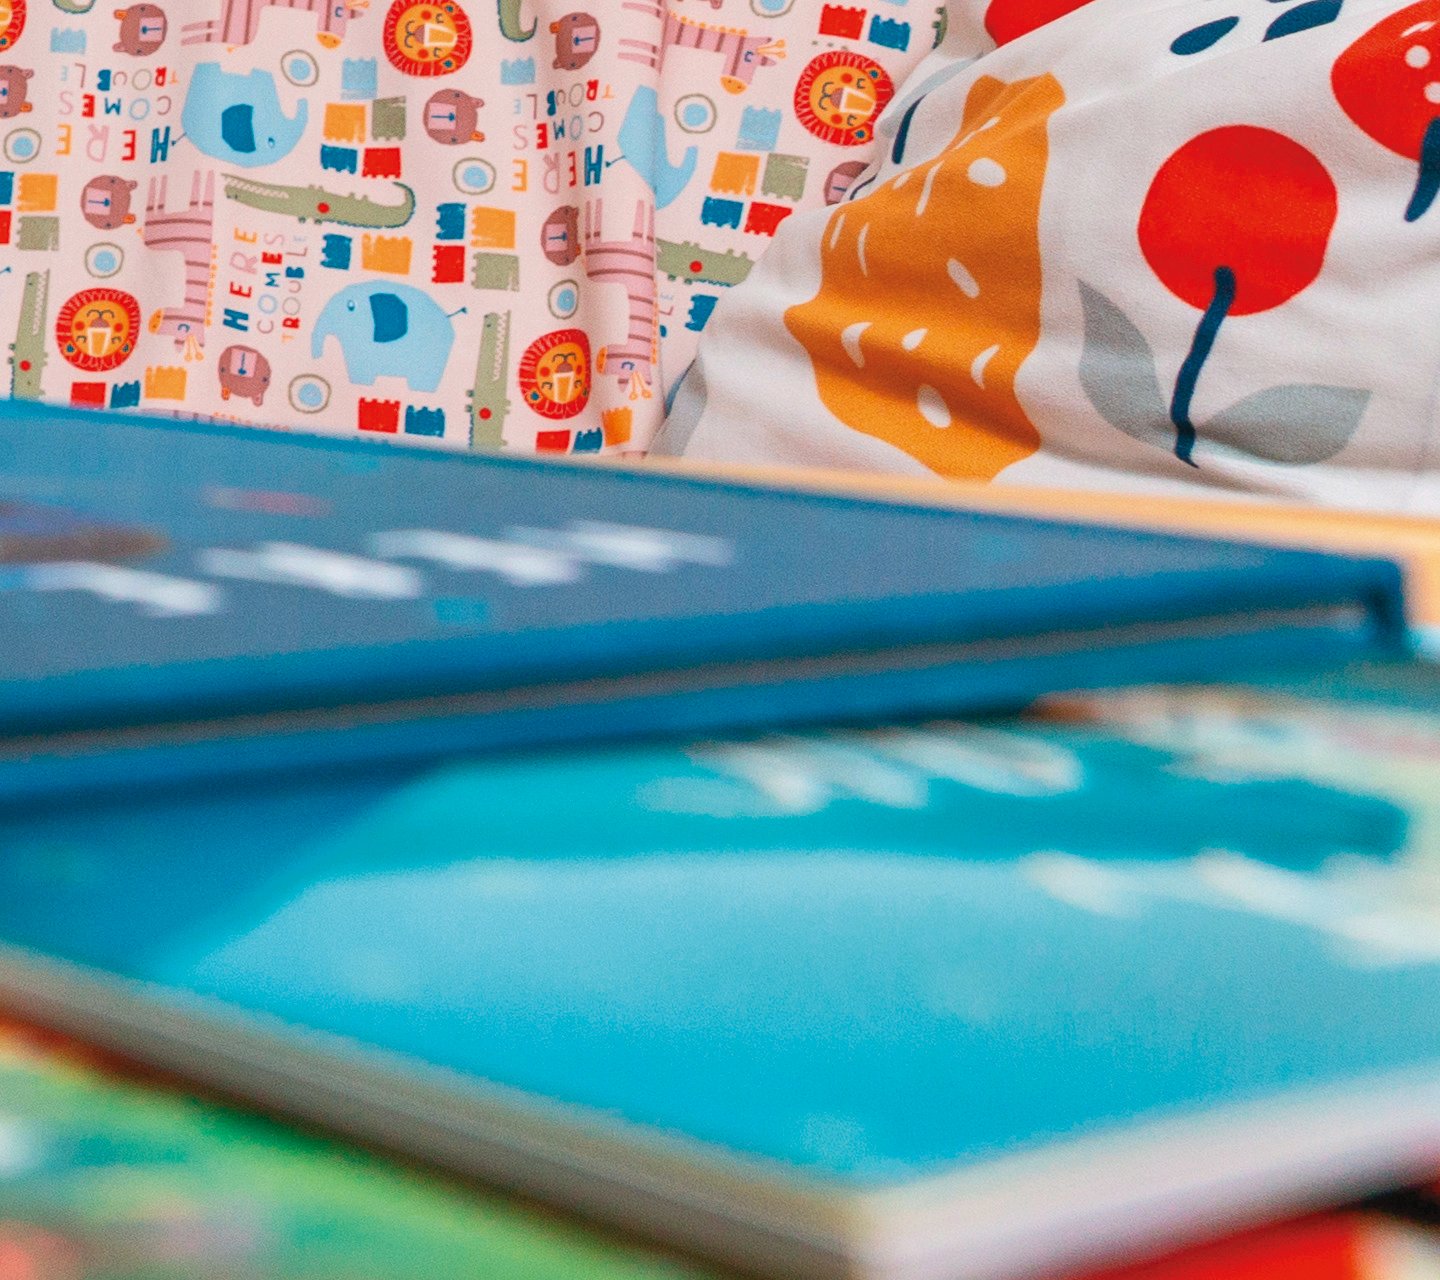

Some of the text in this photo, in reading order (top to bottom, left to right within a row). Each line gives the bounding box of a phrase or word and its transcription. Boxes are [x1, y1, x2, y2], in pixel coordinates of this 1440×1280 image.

[59, 91, 172, 121] COMES
[55, 123, 170, 163] HERE
[513, 111, 605, 150] COMES
[512, 144, 604, 194] HERE
[222, 227, 258, 332] HERE
[256, 233, 284, 334] COMES
